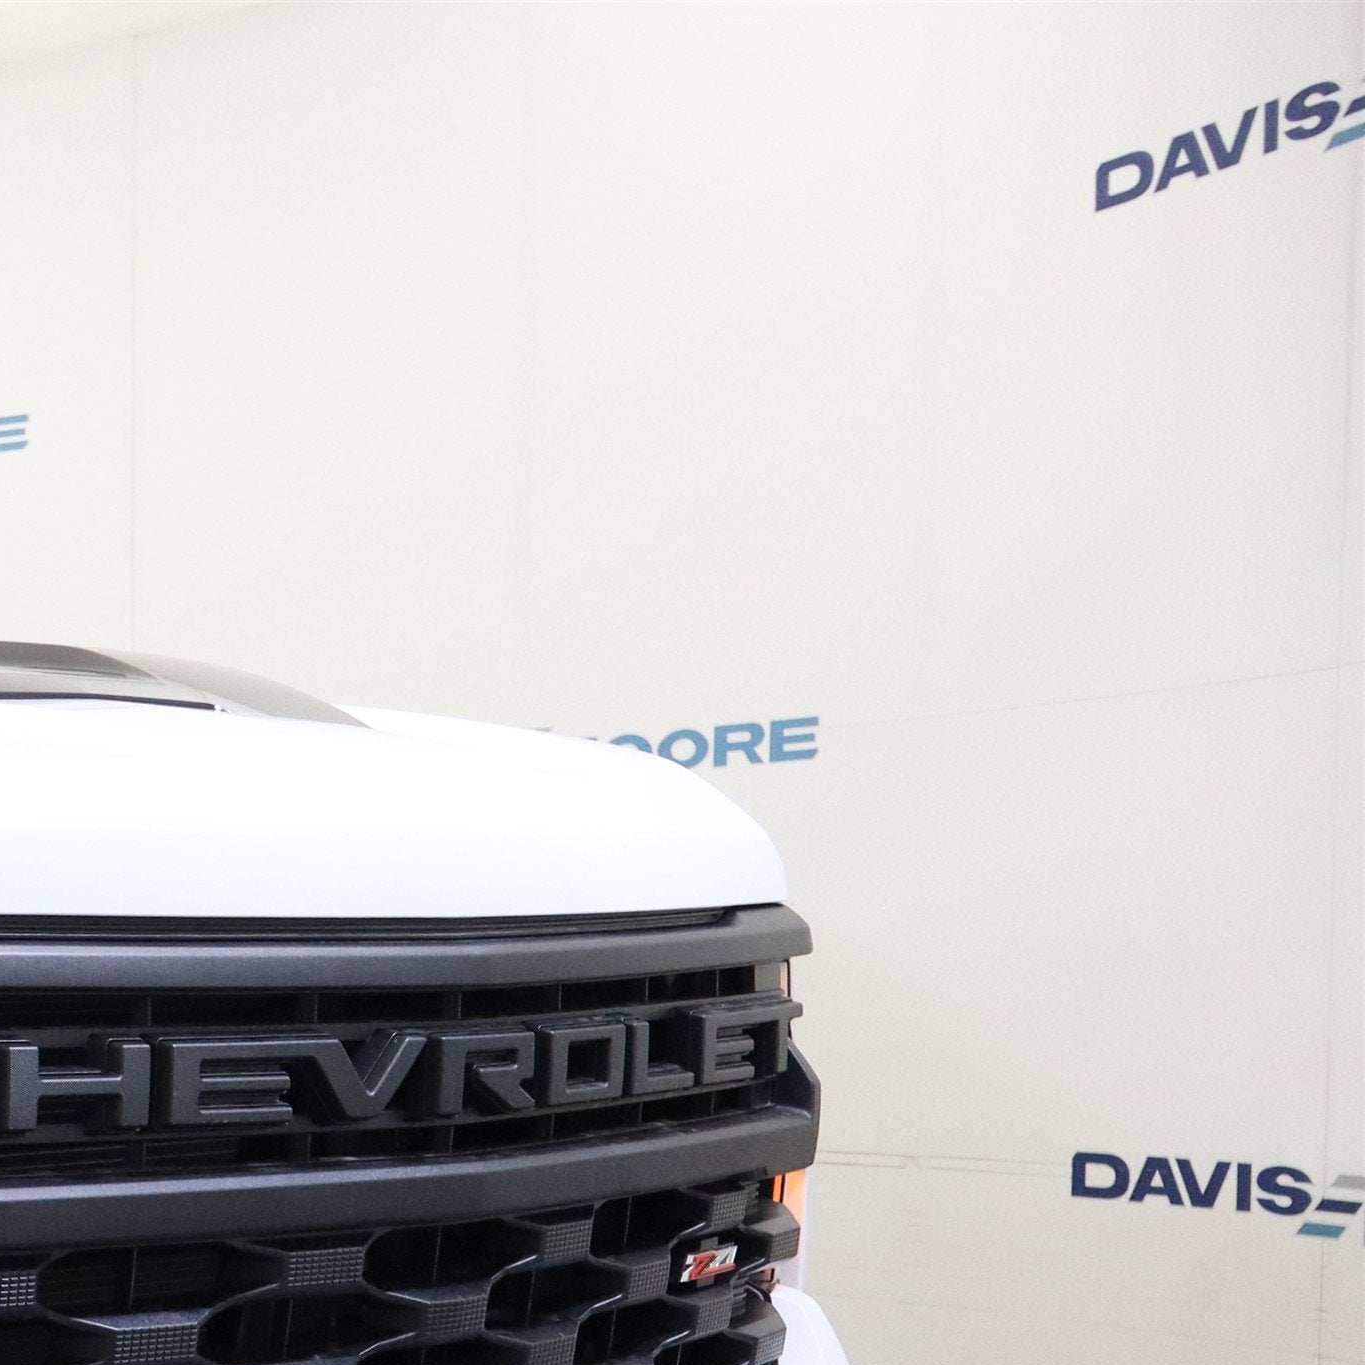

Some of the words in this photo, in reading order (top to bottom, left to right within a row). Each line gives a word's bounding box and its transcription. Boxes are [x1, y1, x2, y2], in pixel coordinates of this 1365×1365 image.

[1095, 81, 1341, 213] DAVIS
[609, 716, 819, 770] ORE
[1071, 1152, 1314, 1216] DAVIS
